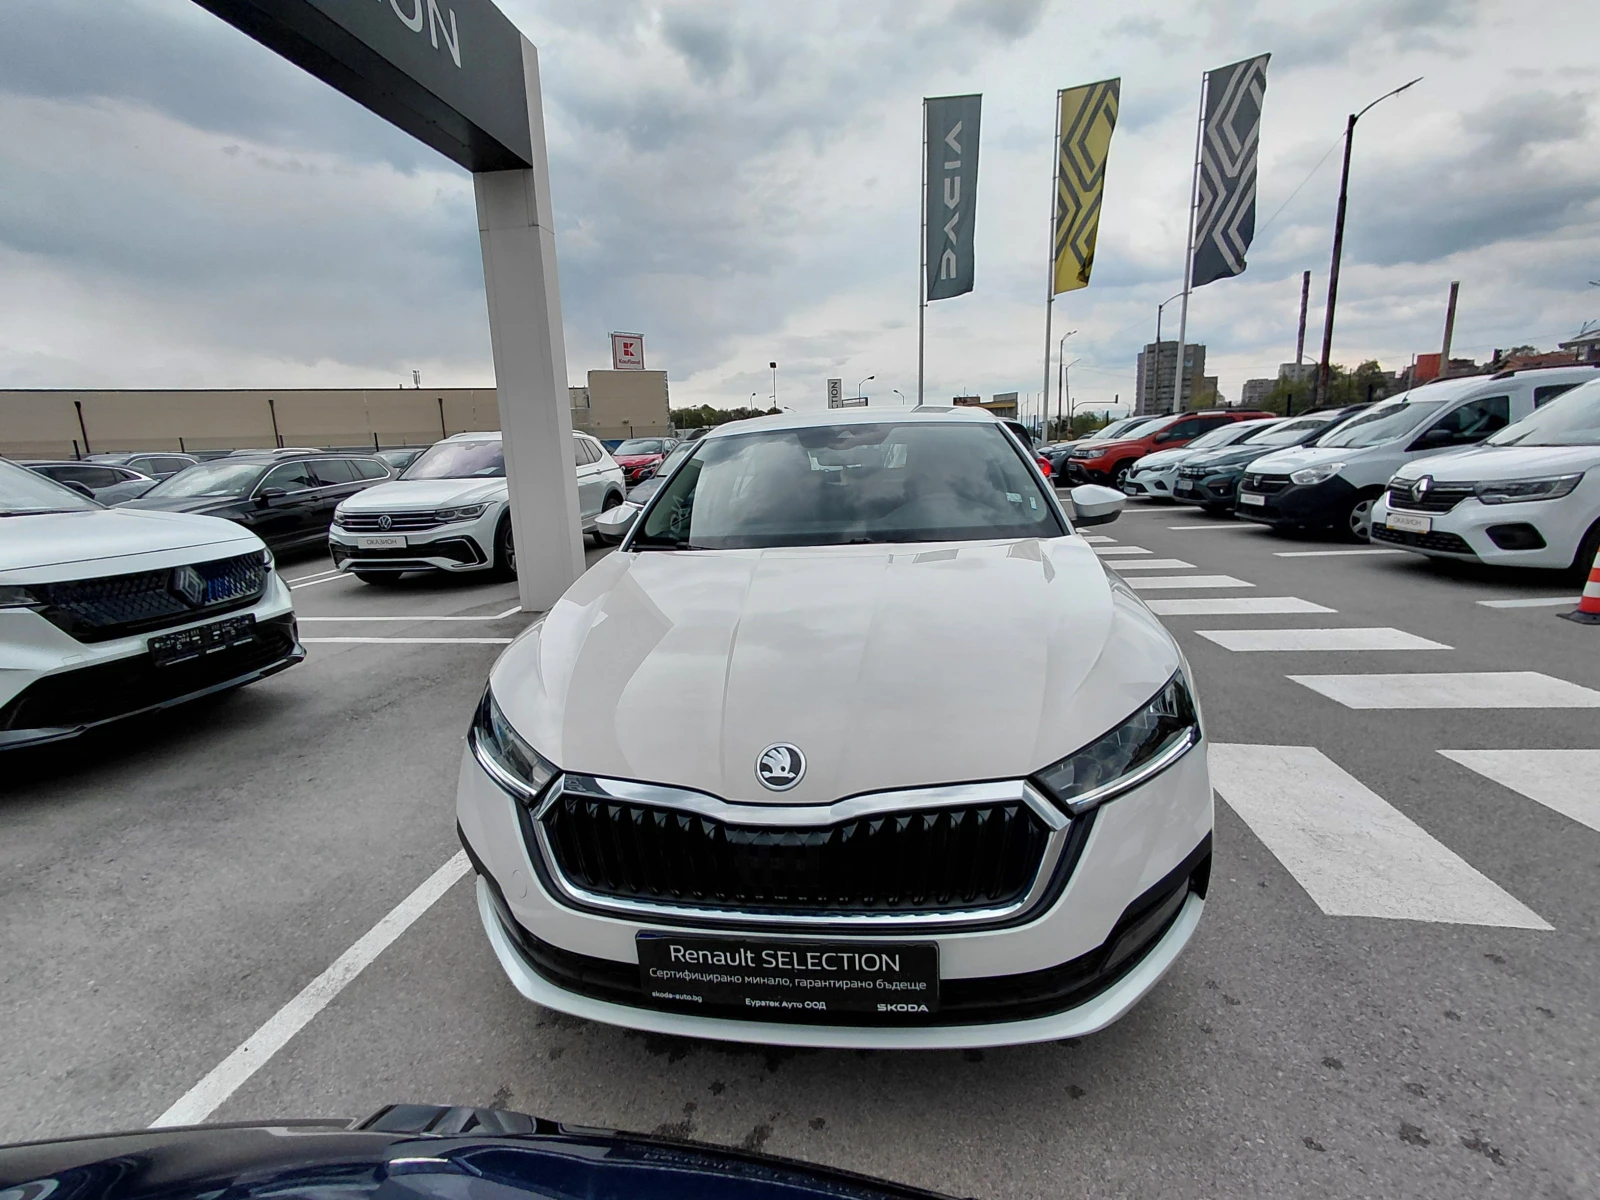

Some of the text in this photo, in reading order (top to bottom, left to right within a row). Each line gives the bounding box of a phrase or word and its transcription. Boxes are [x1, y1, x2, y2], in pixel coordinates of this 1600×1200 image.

[940, 120, 962, 279] DACIA
[669, 945, 900, 972] Renault SELECTION
[649, 967, 927, 990] Сертифицирано минало, гарантирано бъдеще
[652, 990, 703, 1003] skoda-auto.bg
[781, 1001, 803, 1009] Ауто
[804, 1001, 827, 1010] ООД
